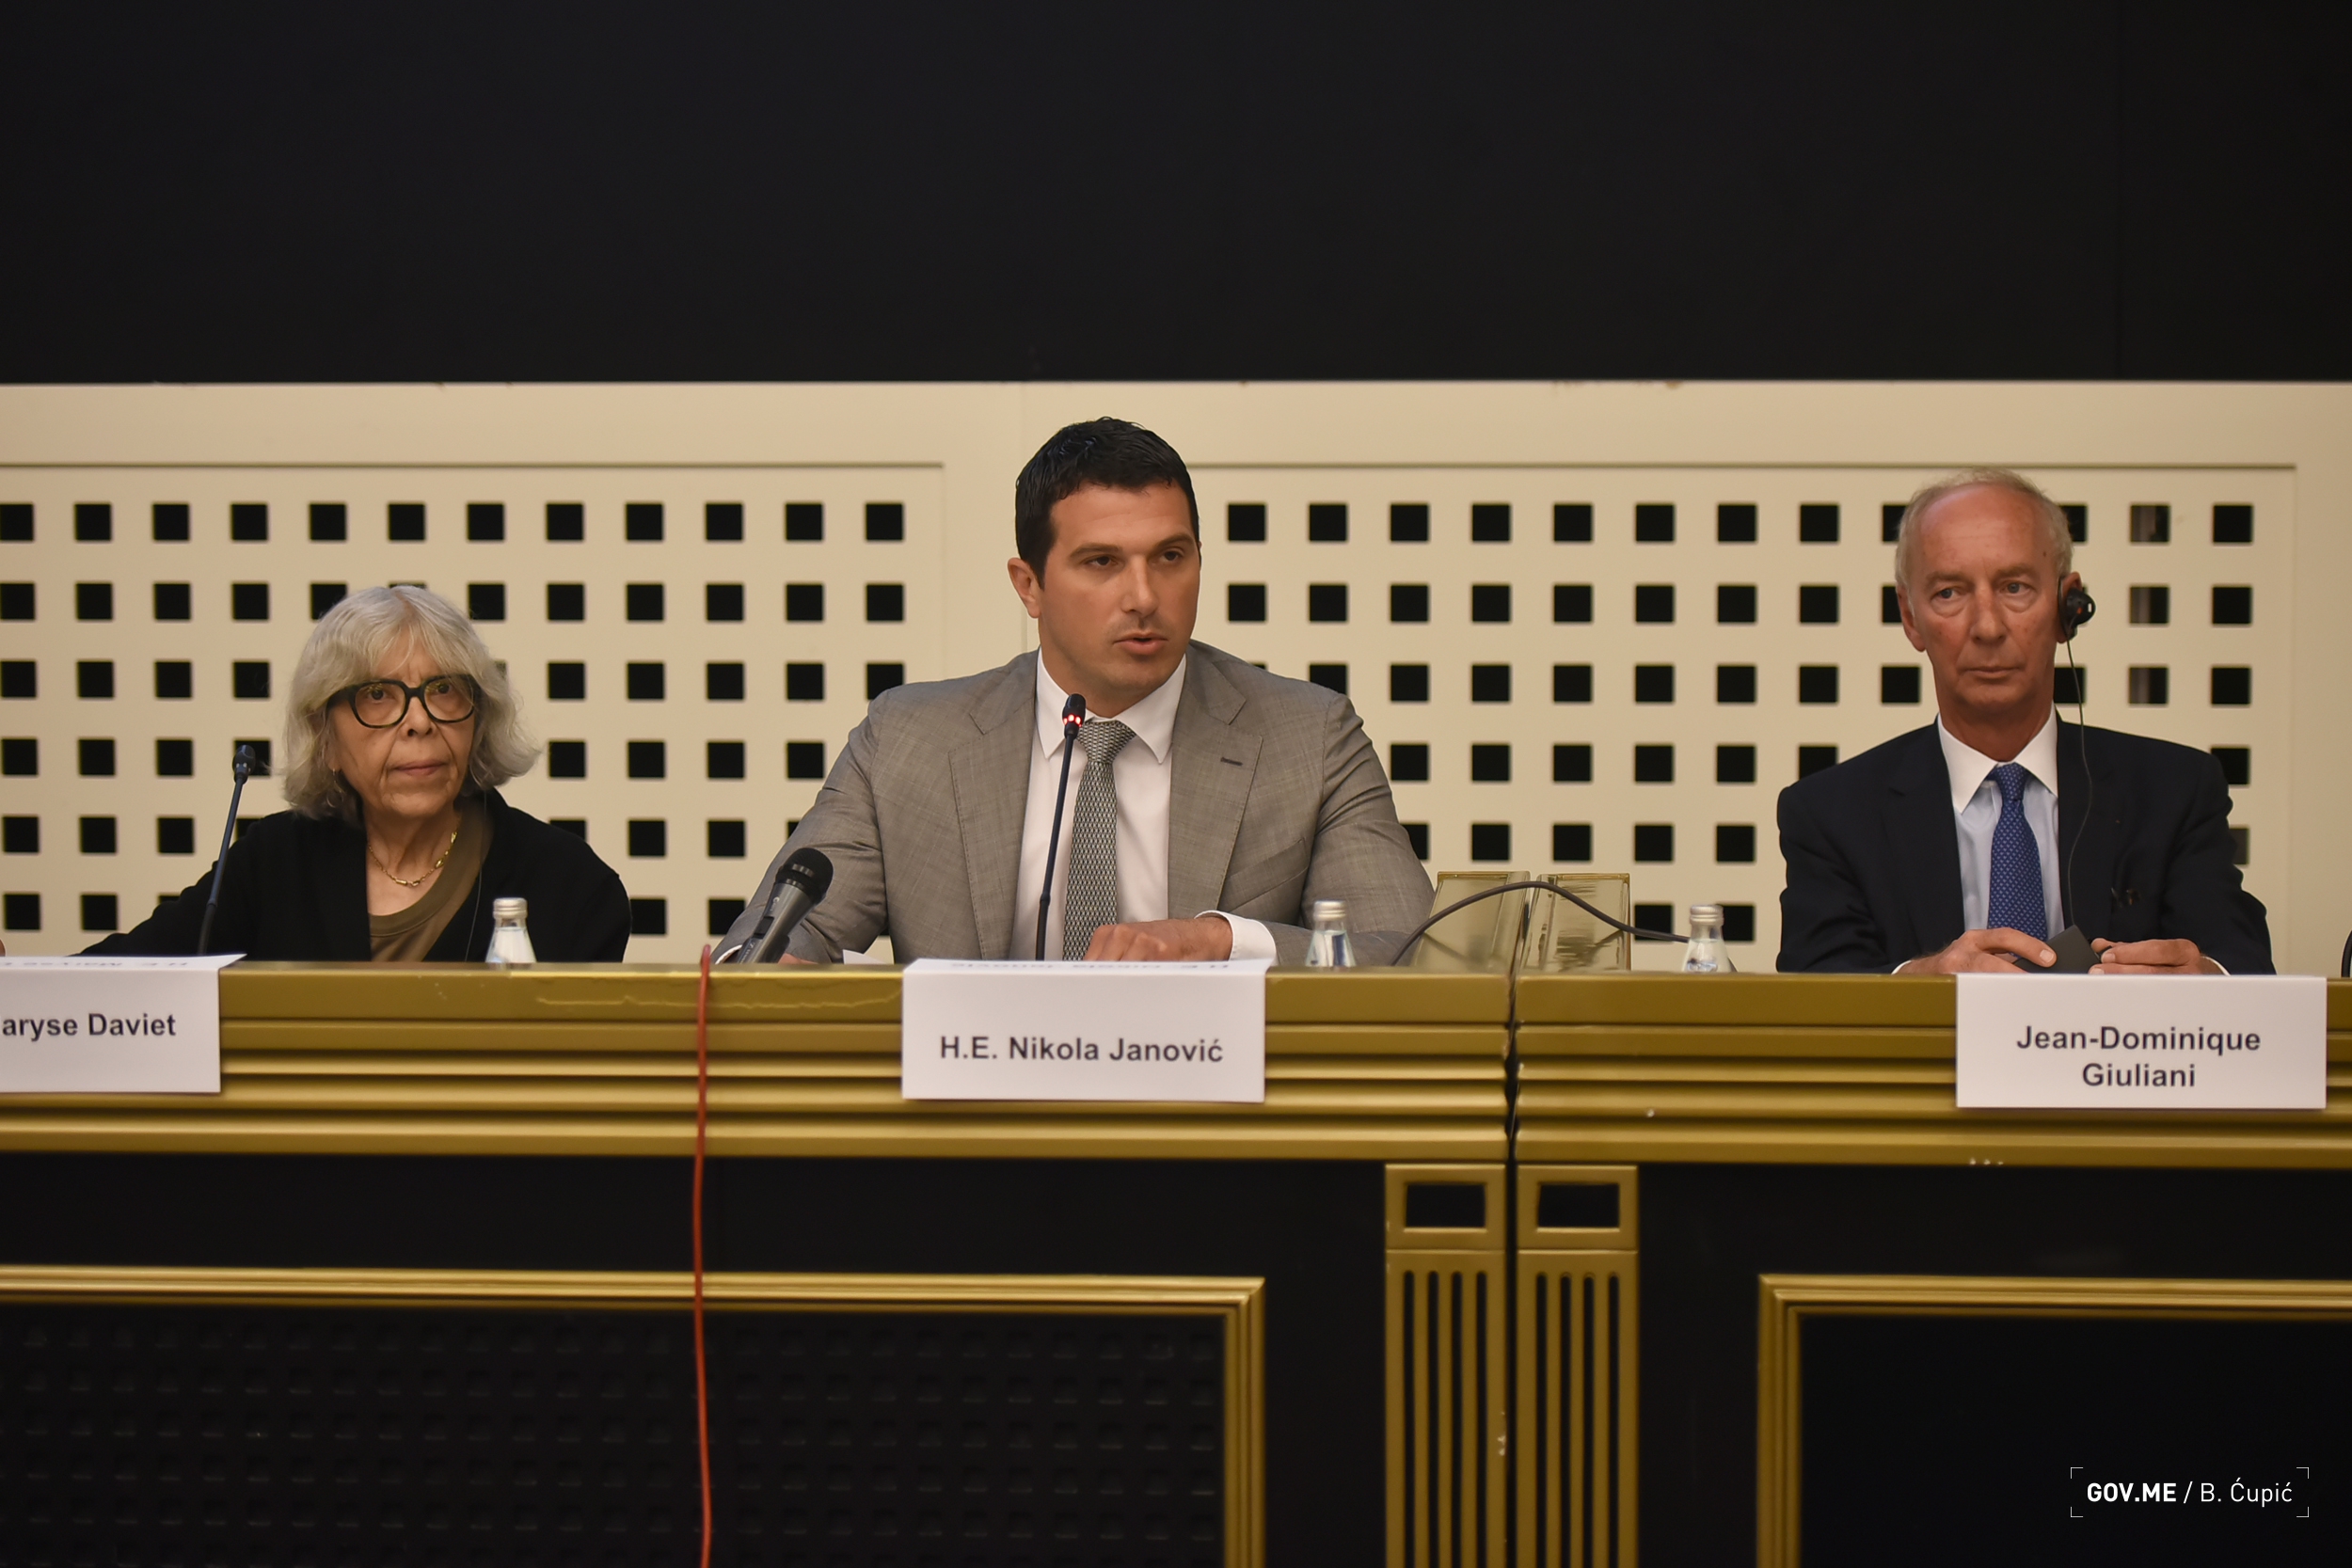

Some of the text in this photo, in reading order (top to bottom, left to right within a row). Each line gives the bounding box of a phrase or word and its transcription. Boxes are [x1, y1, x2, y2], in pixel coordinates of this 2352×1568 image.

[2, 1012, 176, 1042] aryse Daviet
[2016, 1025, 2261, 1056] Jean-Dominique
[941, 1036, 1223, 1063] H.E. Nikola Janović
[2082, 1062, 2195, 1087] Giuliani
